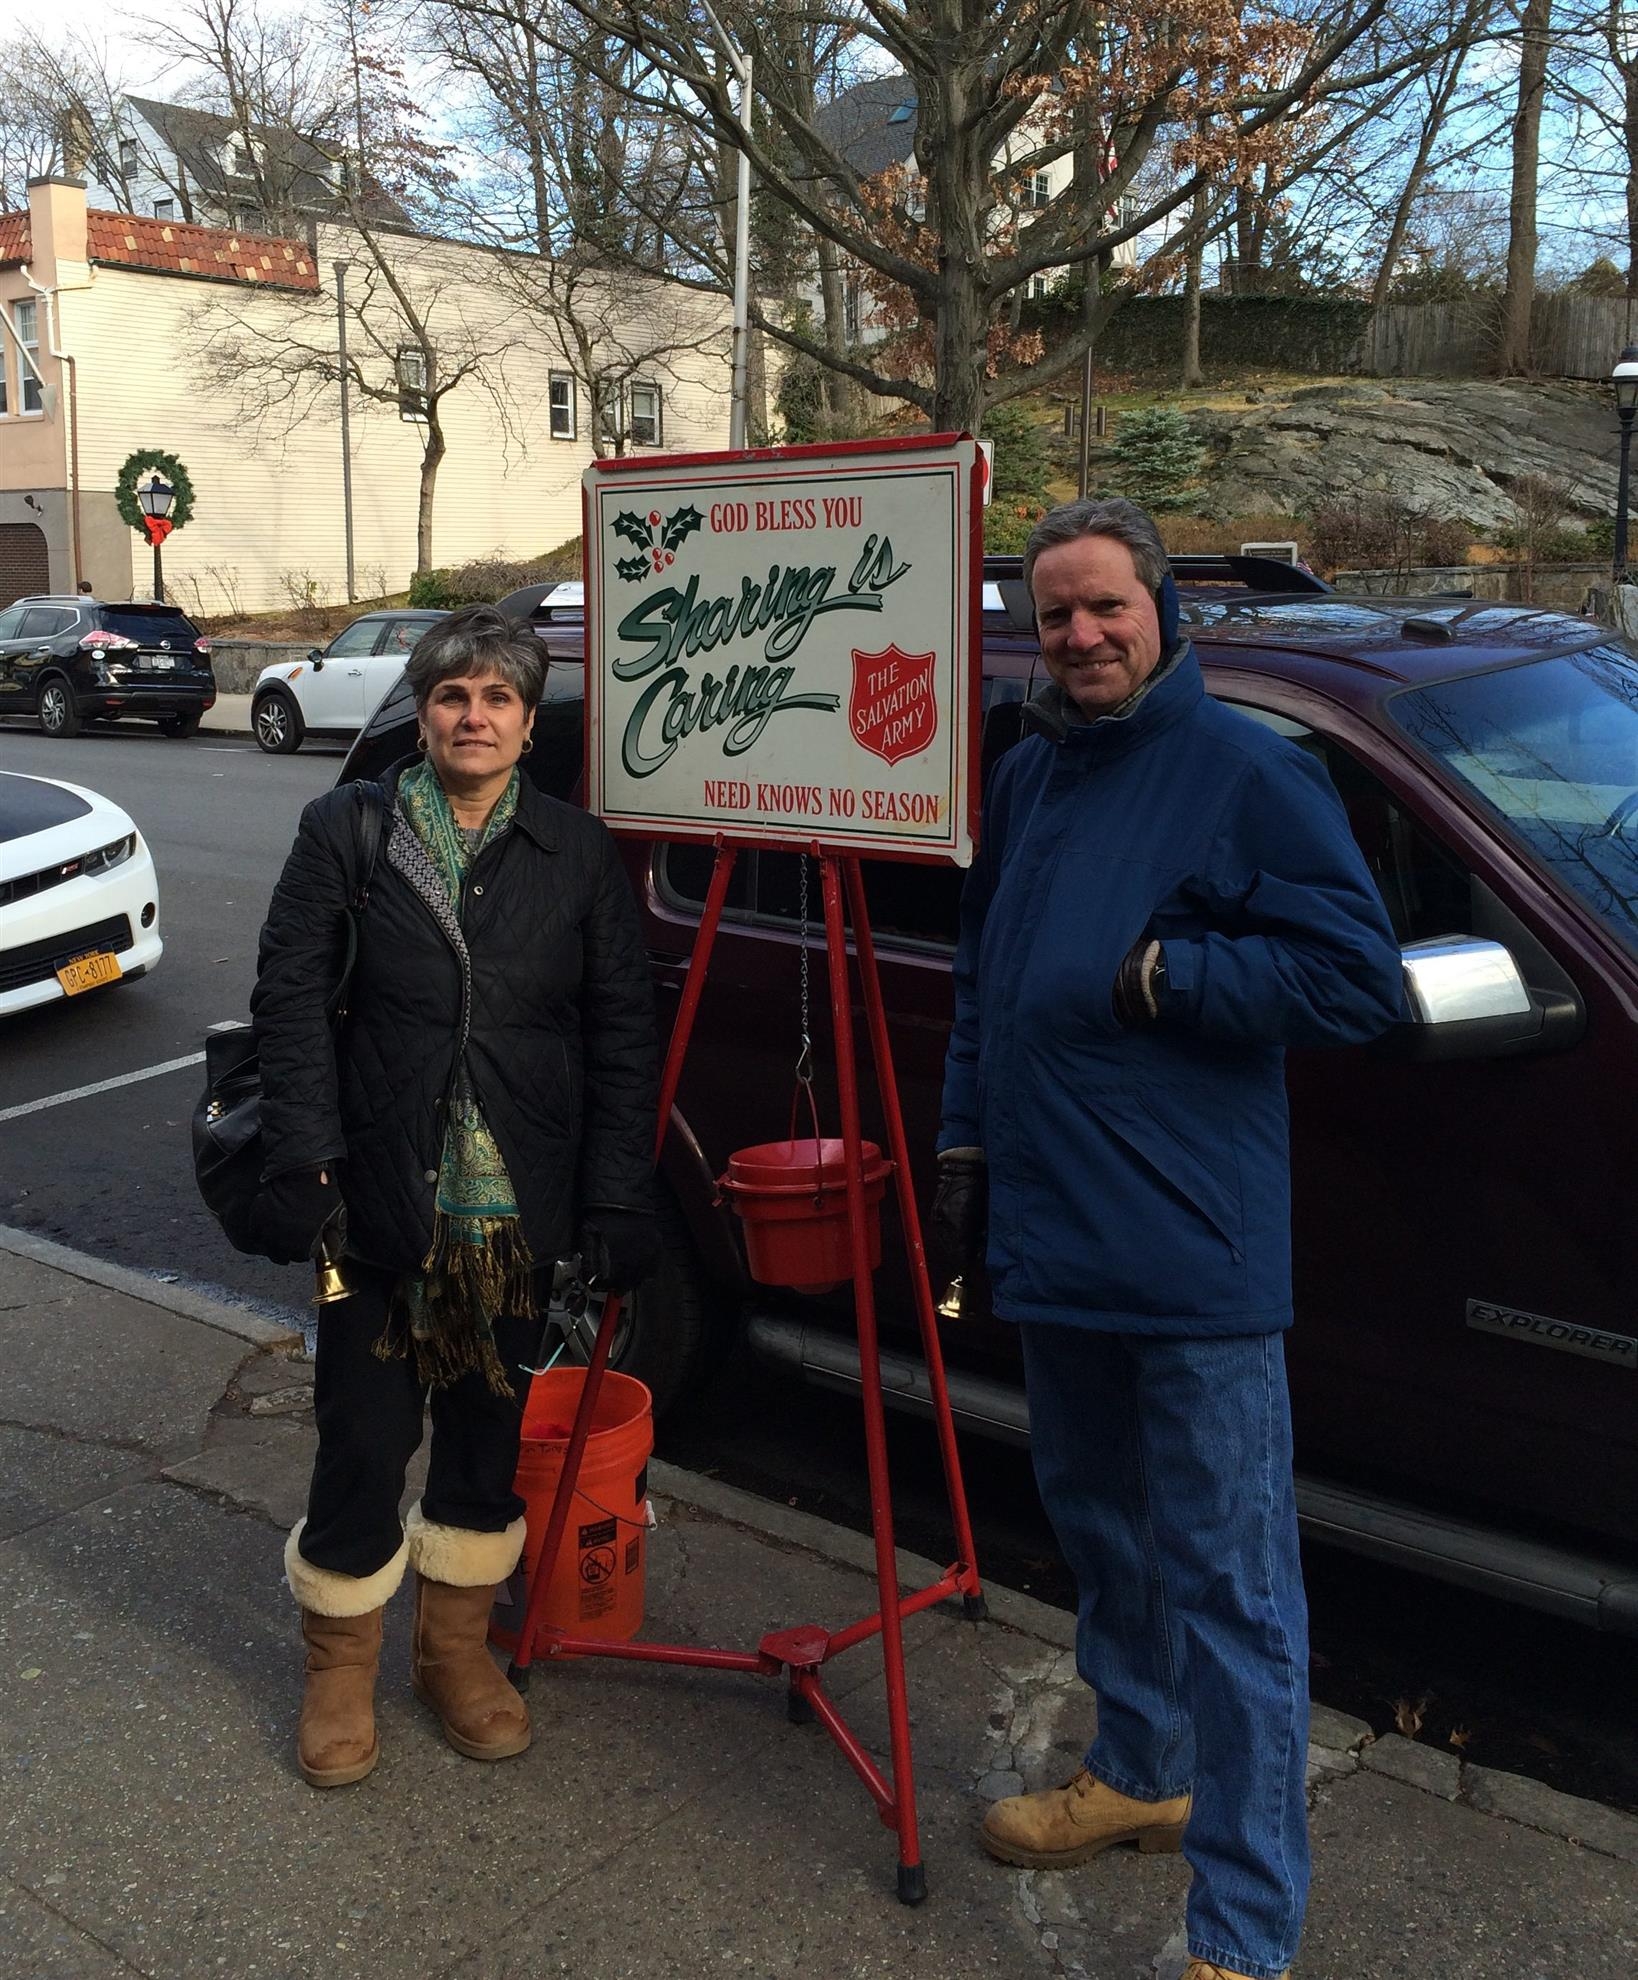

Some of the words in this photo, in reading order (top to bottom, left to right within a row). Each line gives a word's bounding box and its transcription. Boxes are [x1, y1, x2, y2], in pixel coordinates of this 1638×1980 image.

[711, 503, 749, 533] GOD
[755, 499, 817, 531] BLESS
[822, 496, 863, 528] YOU
[612, 565, 883, 682] Sharing
[848, 534, 912, 594] is
[856, 668, 928, 735] SALVATION
[867, 661, 900, 697] THE
[622, 665, 840, 778] Caring
[881, 701, 926, 752] ARMY
[704, 780, 750, 810] NEED
[757, 783, 823, 816] KNOWS
[829, 788, 855, 818] NO
[862, 790, 939, 825] SEASON
[1471, 1305, 1634, 1354] EXPLORER
